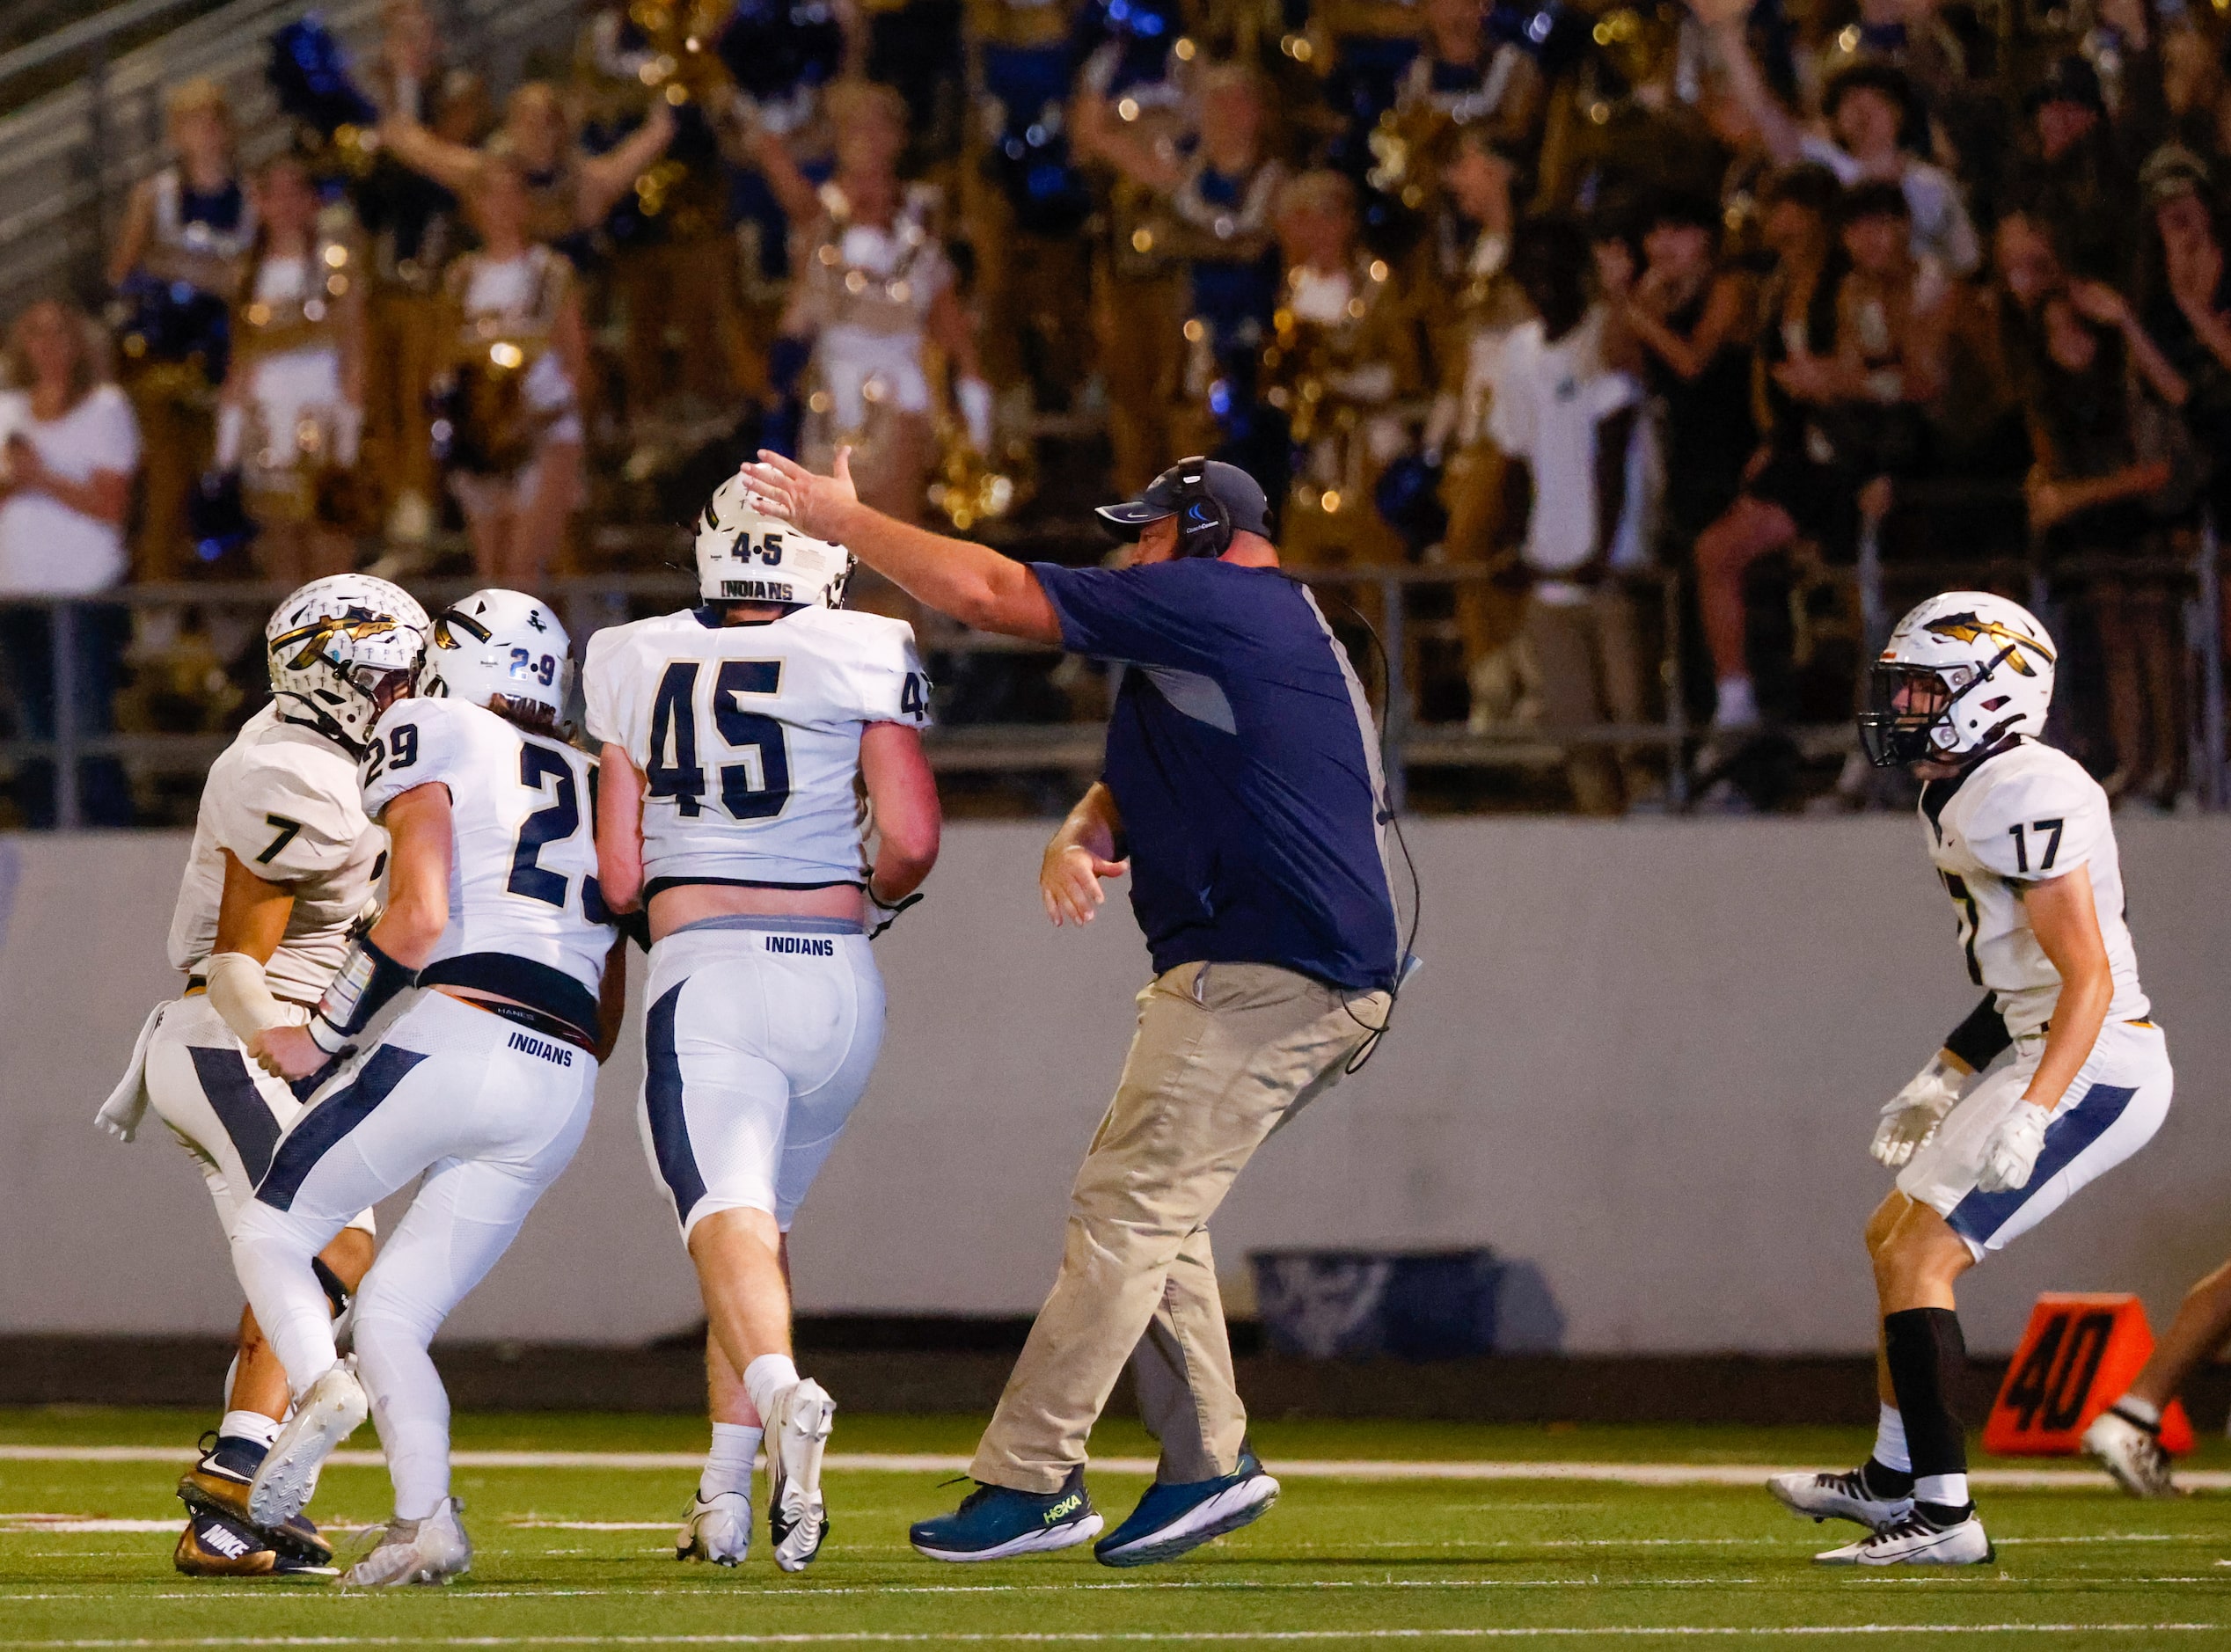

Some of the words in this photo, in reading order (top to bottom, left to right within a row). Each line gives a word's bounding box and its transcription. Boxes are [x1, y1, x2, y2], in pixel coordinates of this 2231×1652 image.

[721, 580, 794, 601] INDIANS
[362, 722, 419, 791] 29
[644, 657, 793, 822] 45
[253, 812, 303, 866] 7
[2008, 818, 2065, 874] 17
[765, 936, 834, 956] INDIANS
[497, 1007, 535, 1021] HANES
[507, 1031, 574, 1068] INDIANS
[2004, 1312, 2116, 1432] 40
[1042, 1494, 1083, 1524] HOKA
[200, 1523, 251, 1561] NIKE
